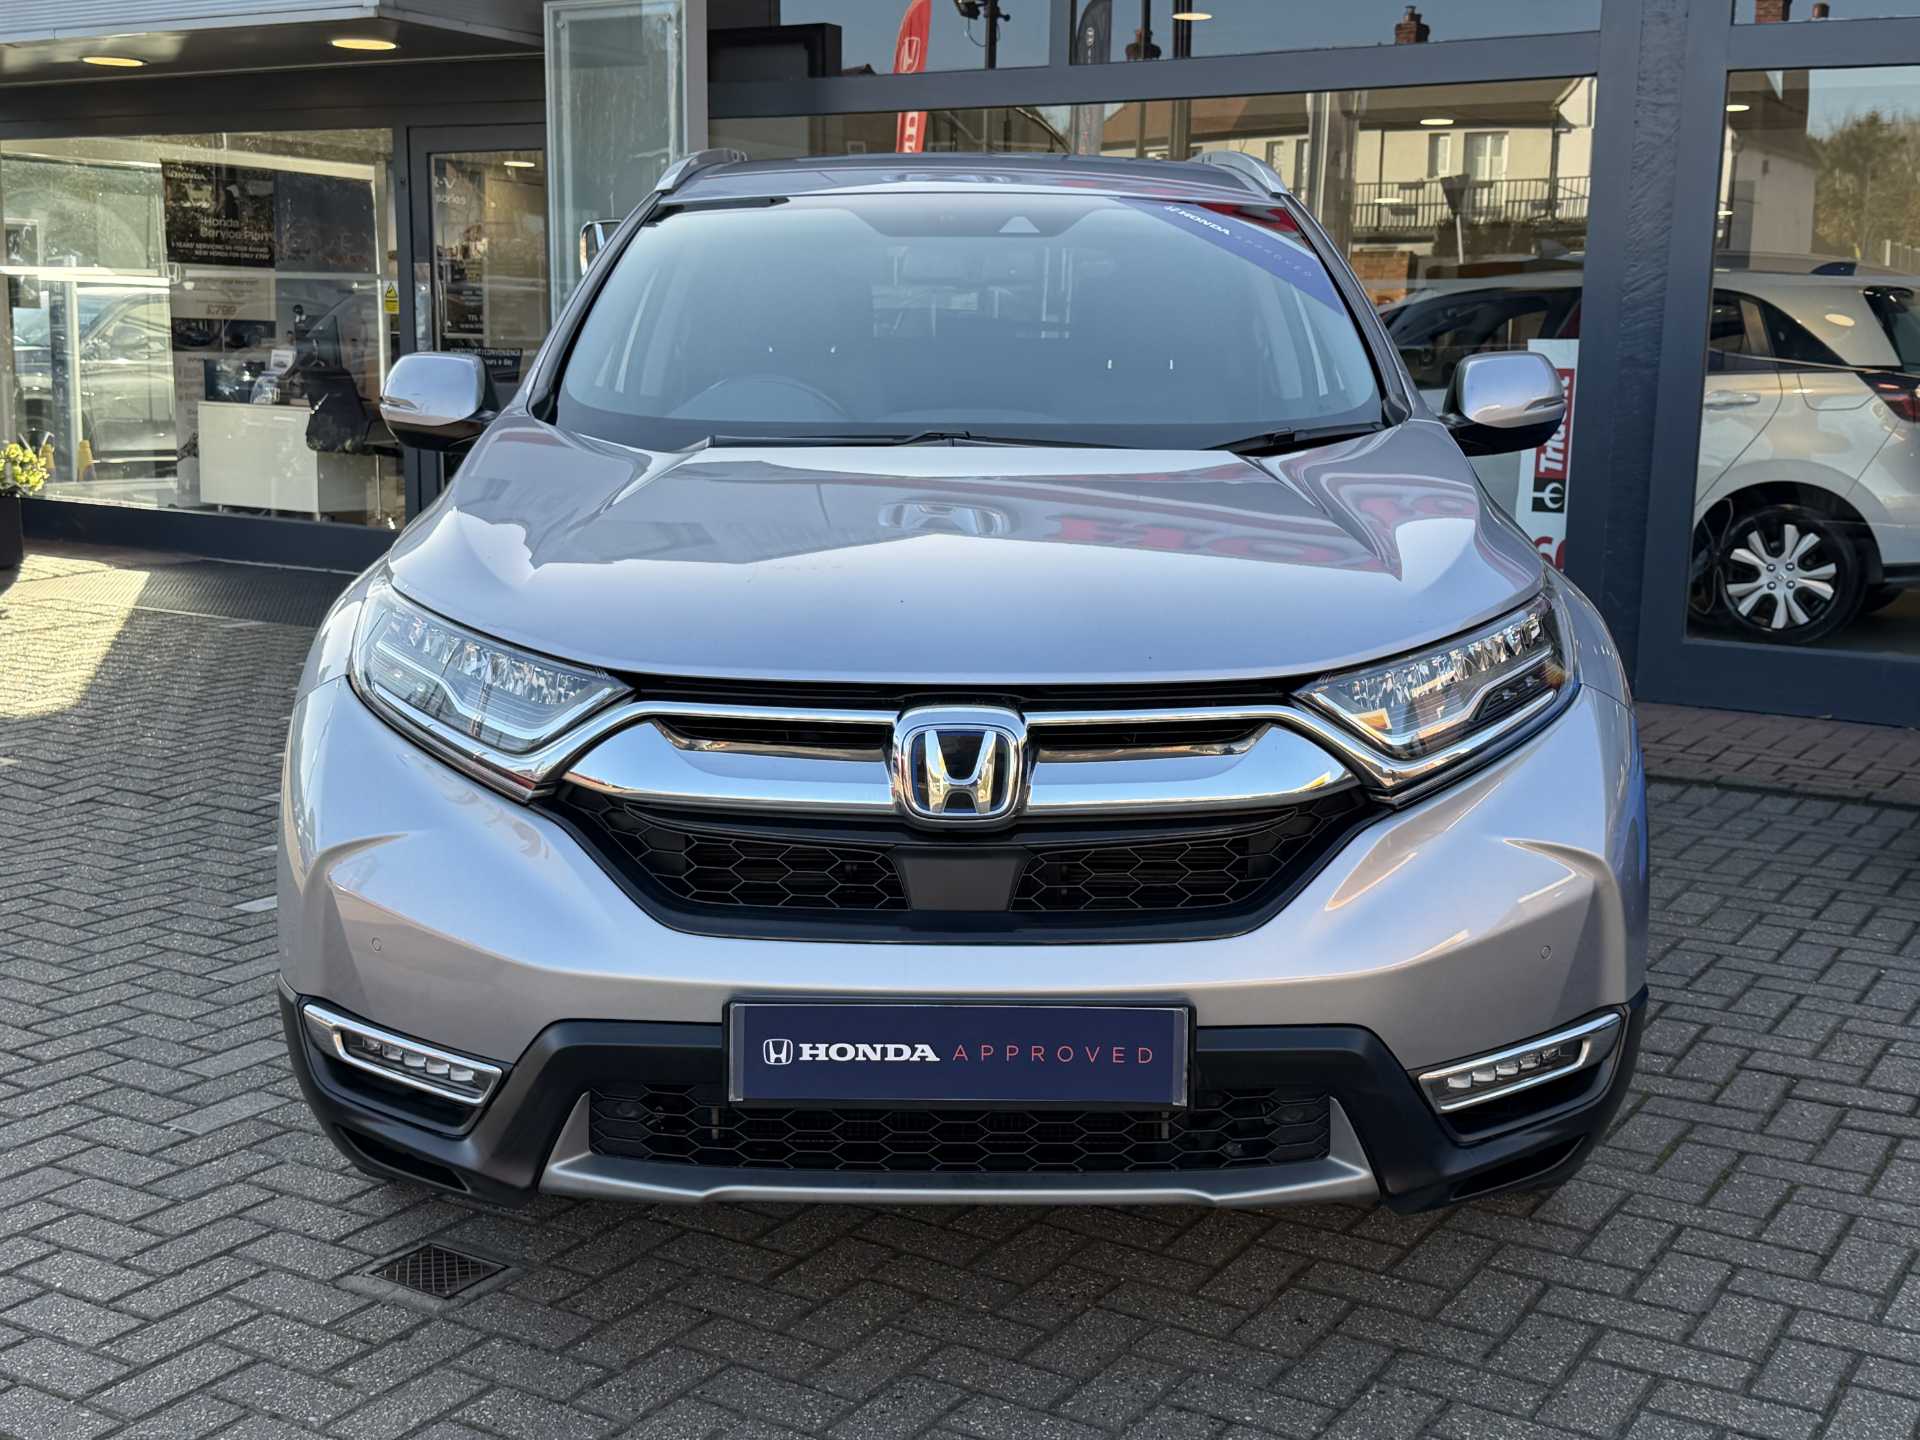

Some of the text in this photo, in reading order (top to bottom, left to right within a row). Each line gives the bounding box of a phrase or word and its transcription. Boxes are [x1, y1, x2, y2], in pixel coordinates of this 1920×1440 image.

[202, 217, 240, 228] Honda
[1178, 210, 1231, 236] HONDA
[1539, 375, 1570, 473] Trit
[799, 1043, 1153, 1064] HONDA APPROVED
